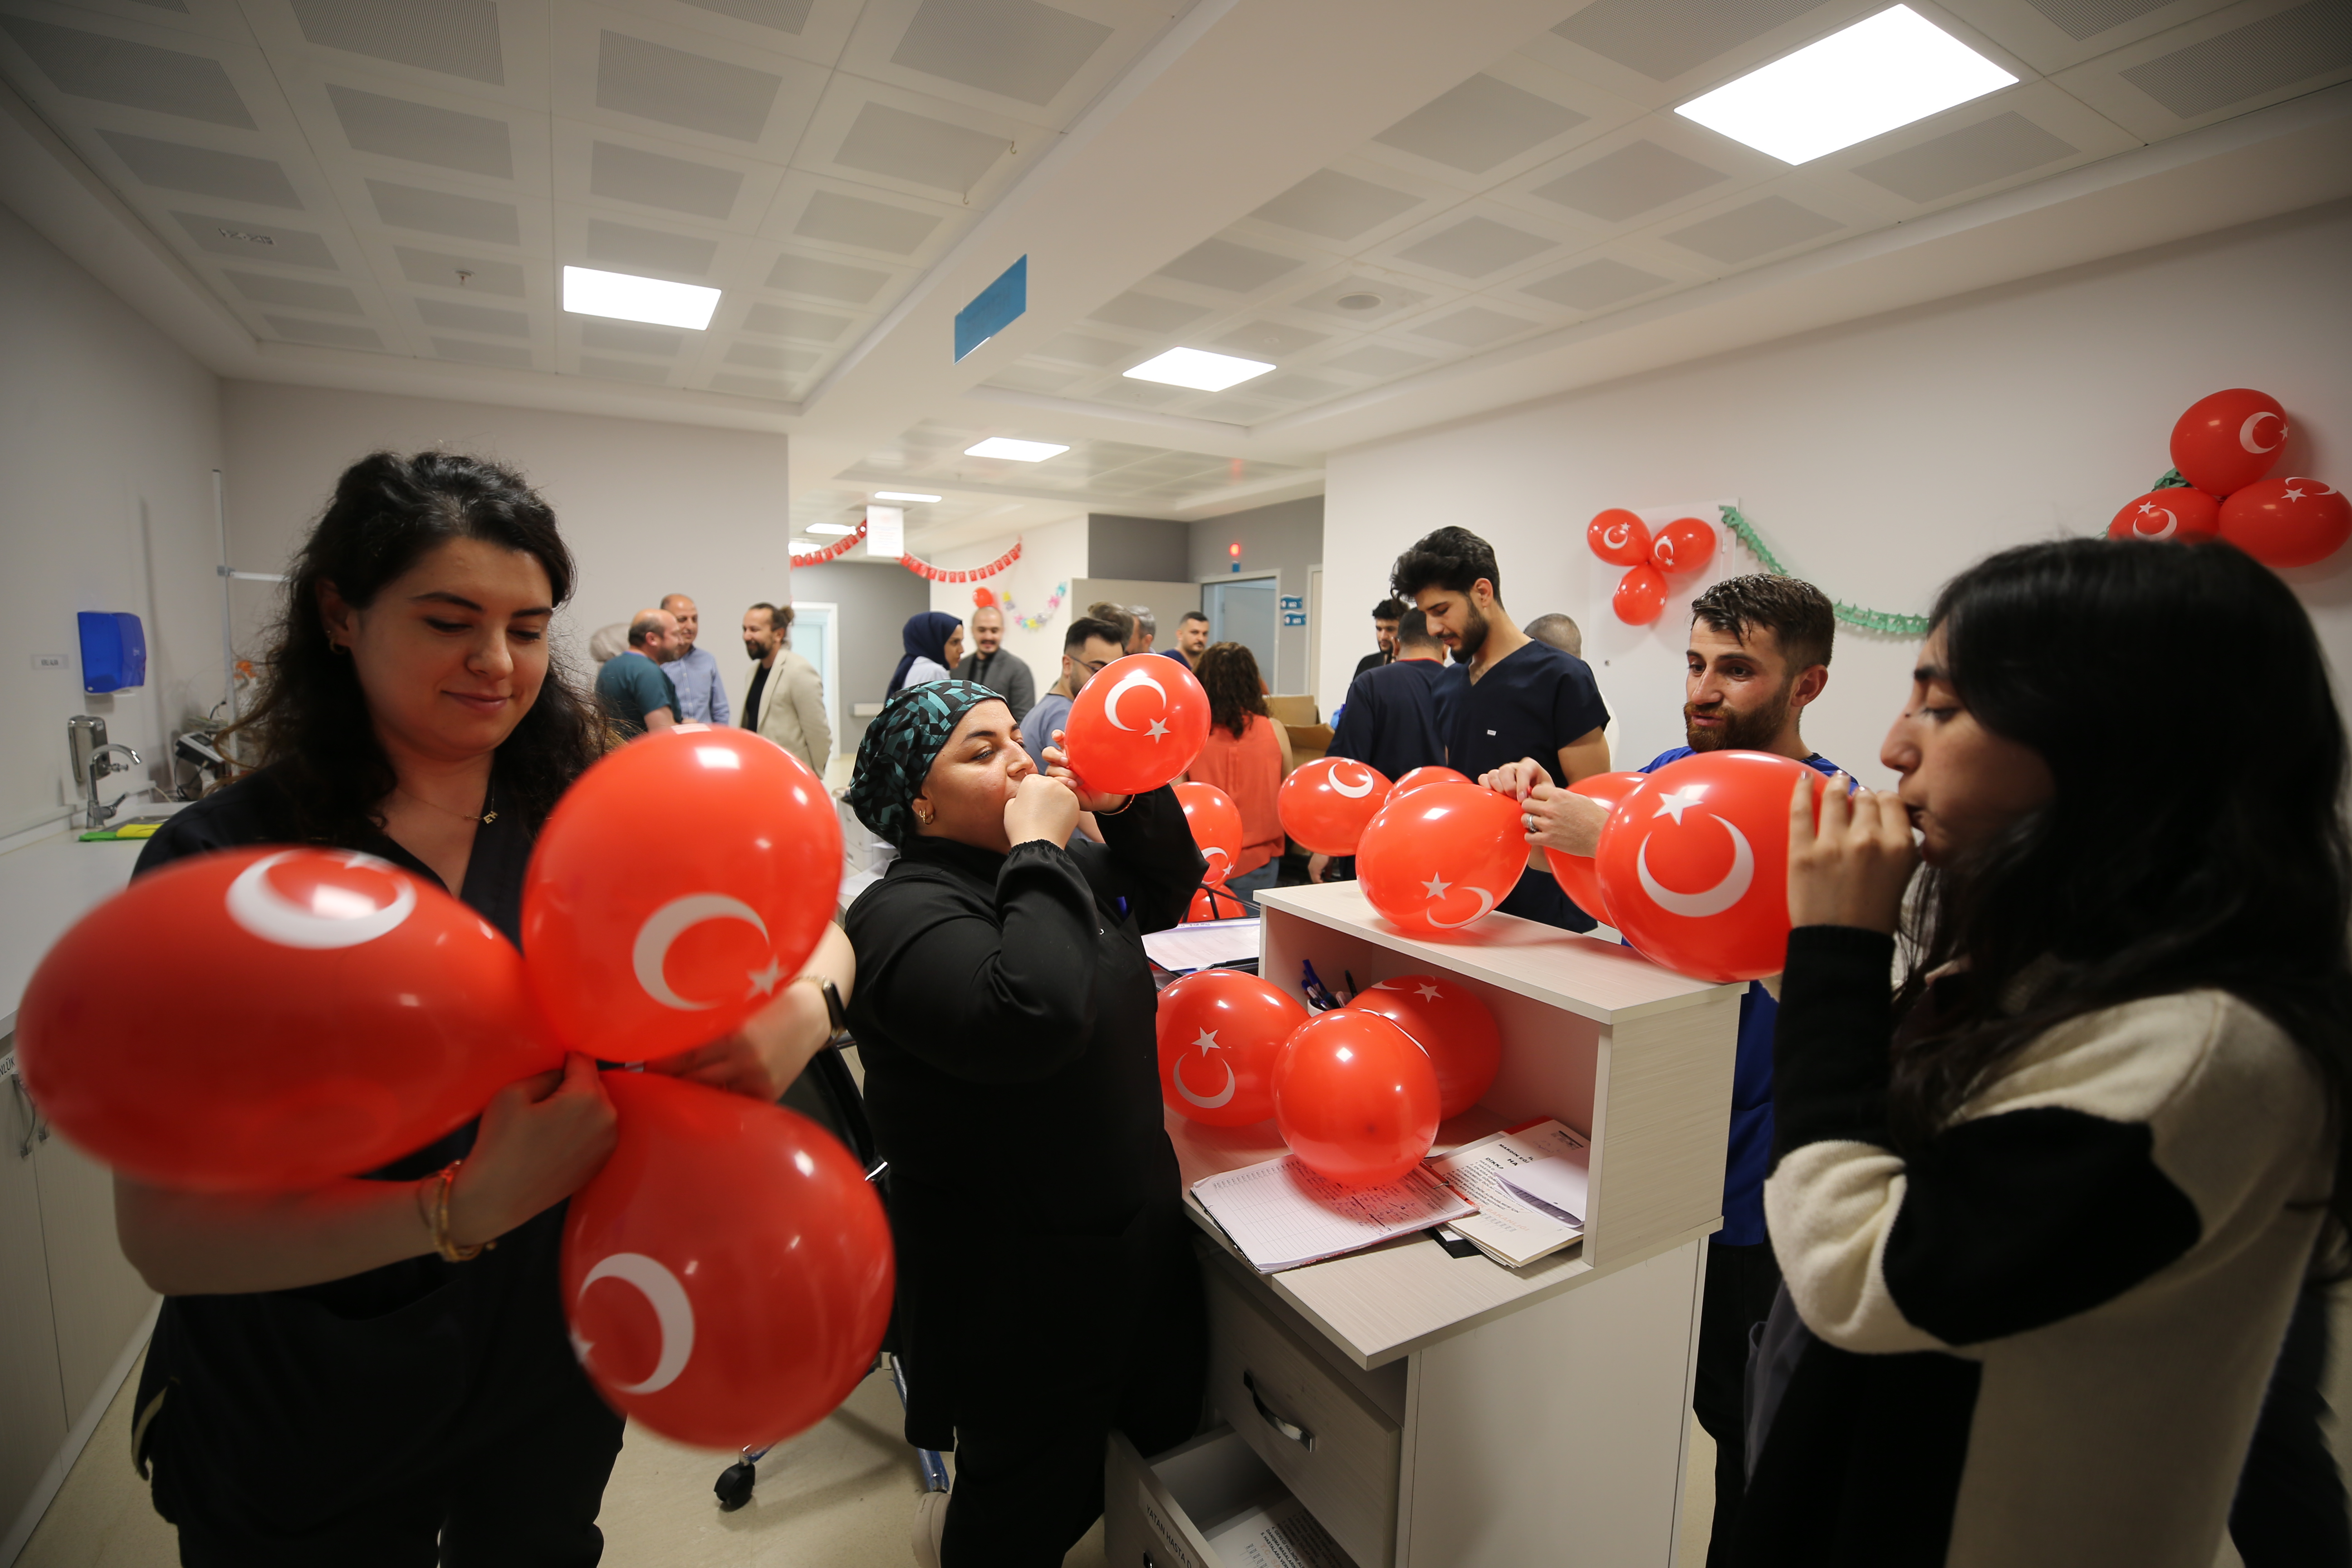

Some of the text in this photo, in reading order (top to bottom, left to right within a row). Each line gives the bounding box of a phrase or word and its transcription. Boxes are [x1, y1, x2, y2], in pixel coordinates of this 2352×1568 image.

[1499, 1144, 1519, 1157] MARDİN
[1147, 1504, 1165, 1534] YATAN
[1166, 1531, 1186, 1563] HASTA
[1266, 1529, 1279, 1546] DANIŞMA
[1263, 1536, 1281, 1559] HASTALARA
[1274, 1530, 1287, 1544] GEREĞİ
[1285, 1544, 1299, 1561] HALİNDE
